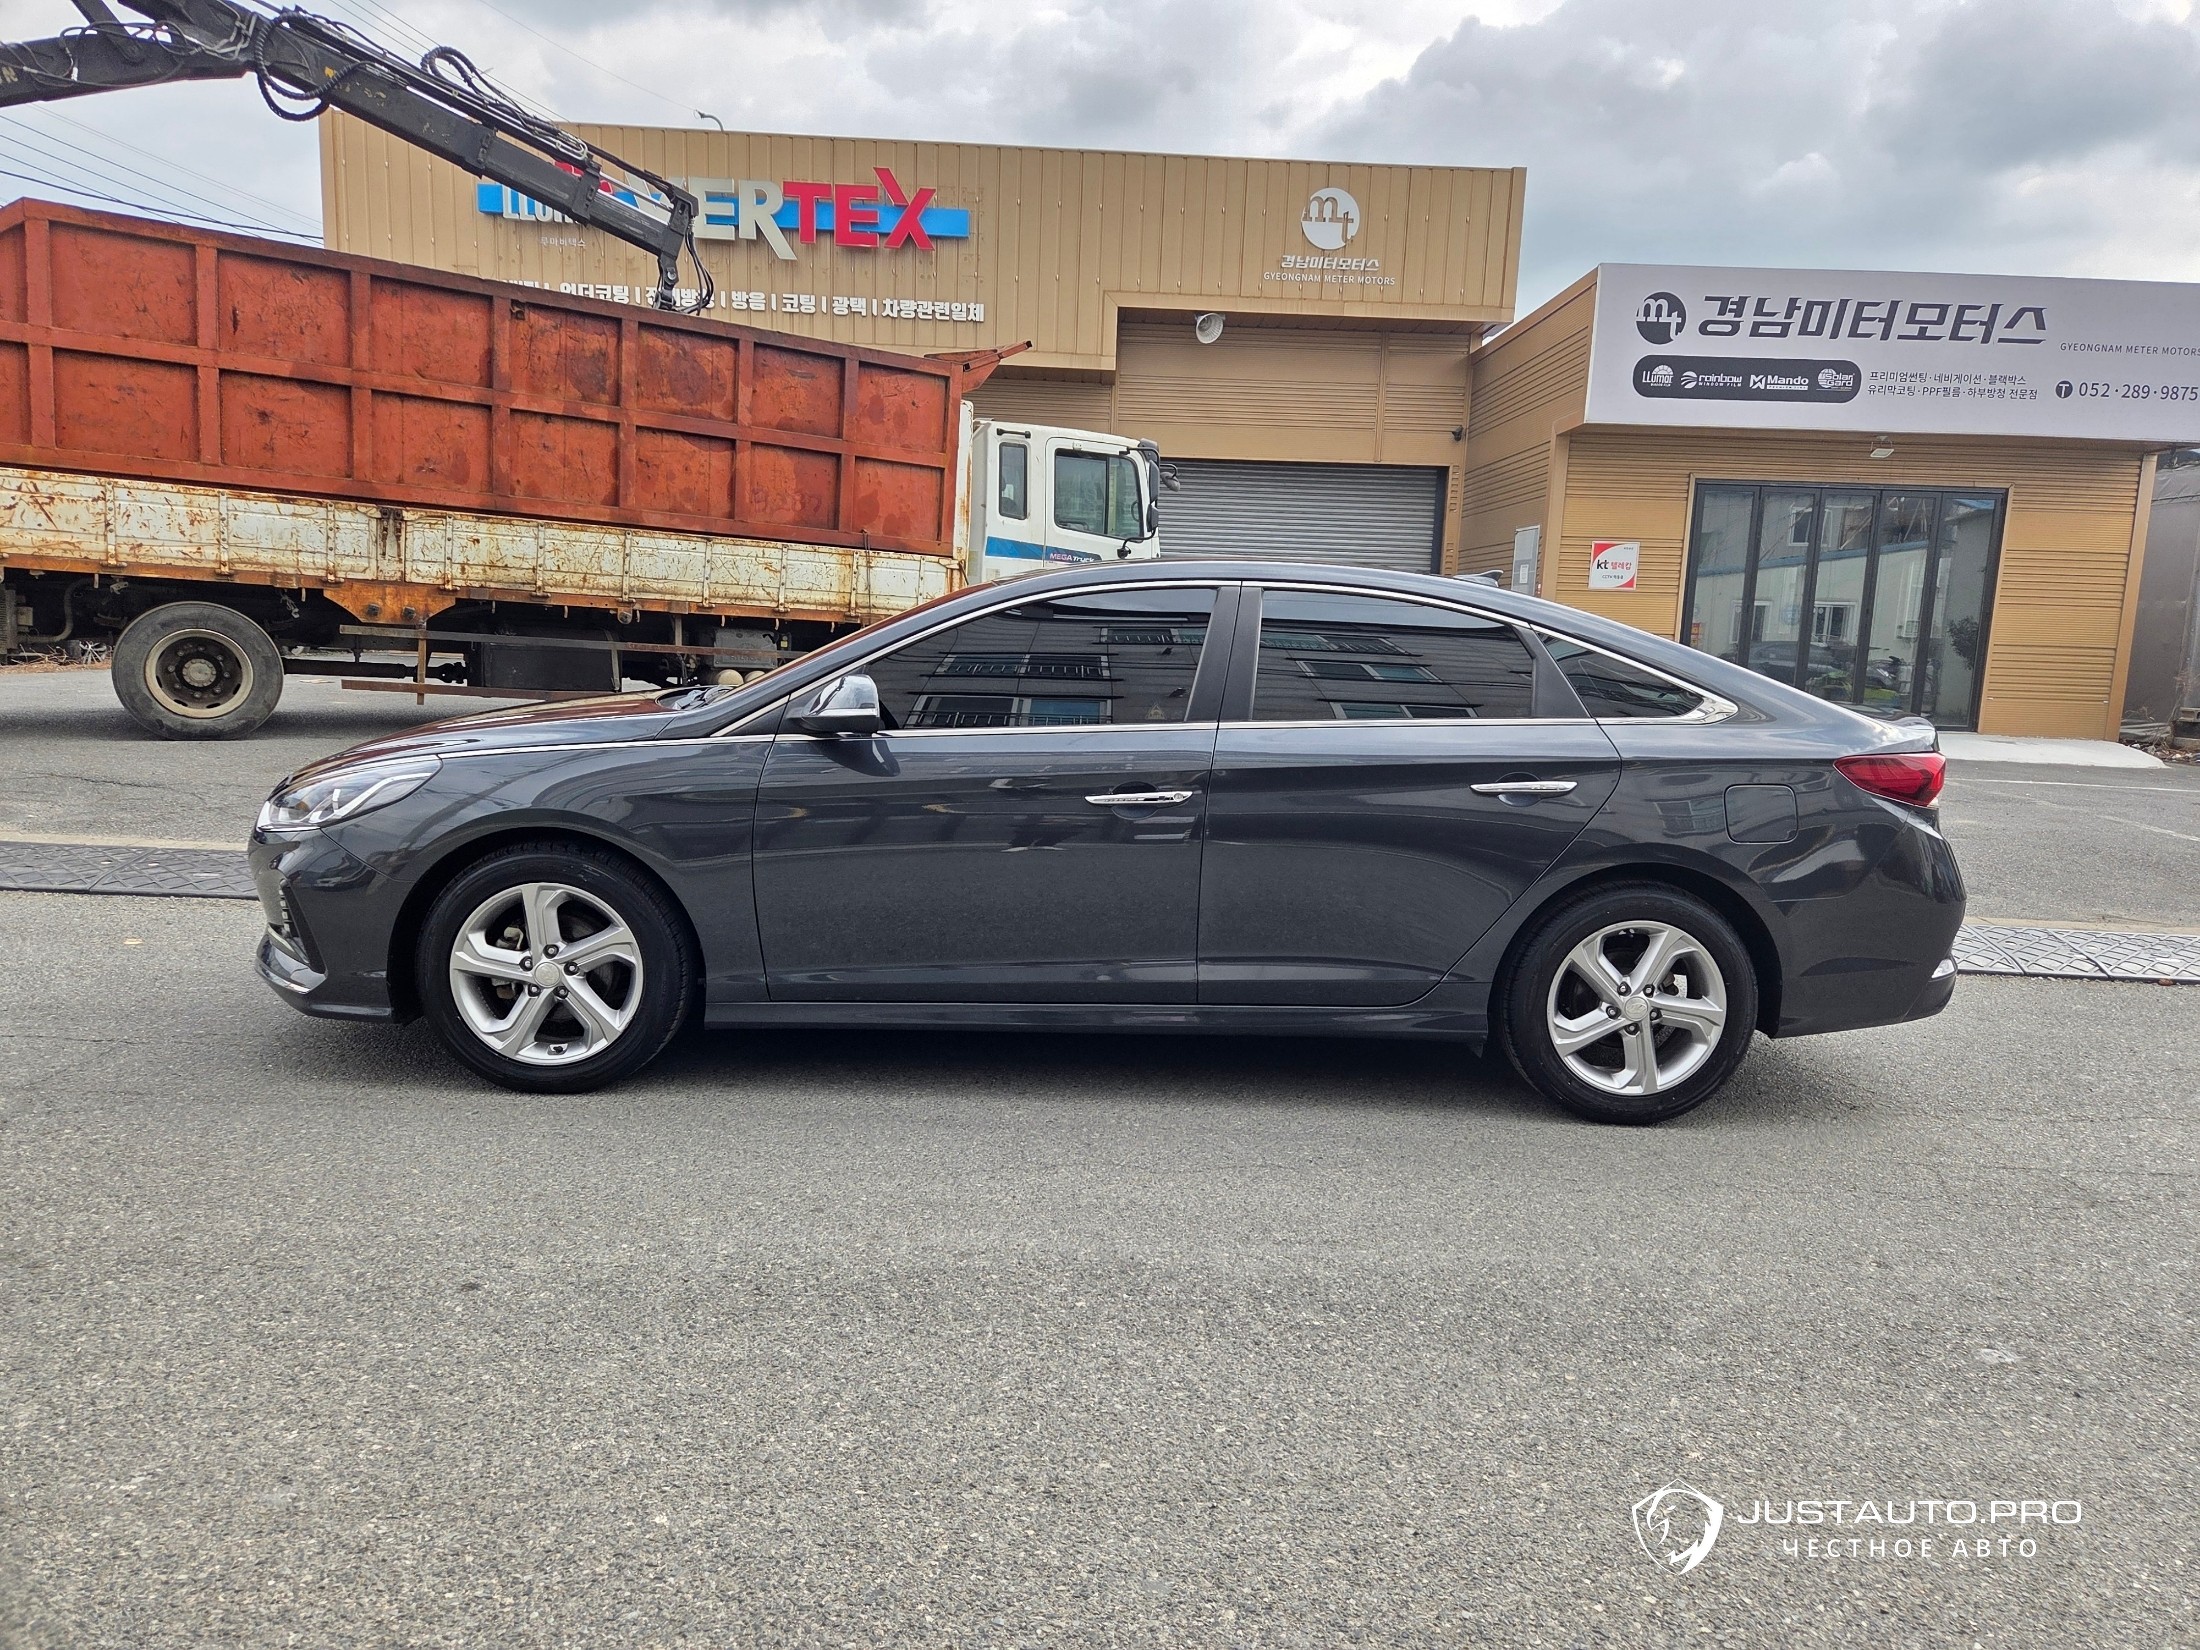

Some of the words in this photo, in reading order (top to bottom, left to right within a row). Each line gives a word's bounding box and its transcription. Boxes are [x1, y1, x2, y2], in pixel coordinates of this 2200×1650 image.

[1281, 255, 1380, 271] 경남미터모터스
[1263, 271, 1321, 283] GYEONGNAM
[1324, 274, 1354, 284] METER
[1357, 276, 1395, 285] MOTORS
[731, 291, 766, 311] 방음
[781, 293, 816, 314] 코팅
[832, 296, 867, 317] 광택
[882, 298, 985, 323] 차량관련일체
[1698, 294, 2047, 345] 경남미터모터스
[2059, 342, 2122, 353] GYEONGNAM
[2125, 345, 2159, 355] METER
[2161, 346, 2200, 357] MOTORS
[1698, 373, 1742, 383] rainbow
[1767, 374, 1809, 385] Mando
[2008, 388, 2038, 400] 전문점
[1050, 552, 1073, 561] MEGA
[1596, 559, 1610, 570] kt
